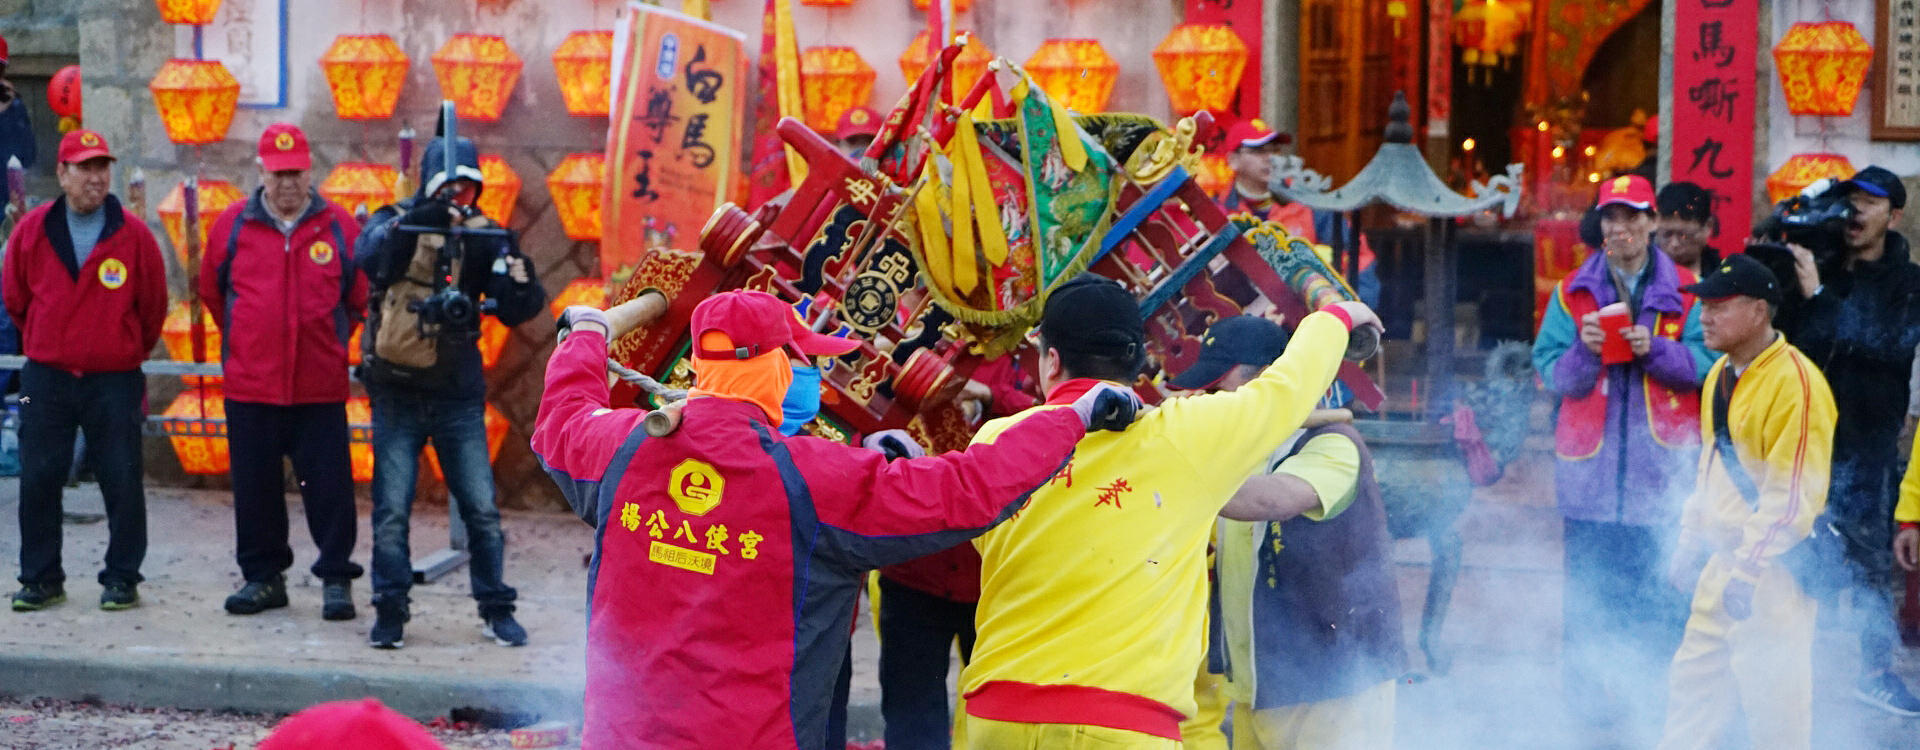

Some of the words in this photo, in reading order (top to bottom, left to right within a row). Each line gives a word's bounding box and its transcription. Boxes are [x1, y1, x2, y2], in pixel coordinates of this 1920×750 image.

[632, 84, 681, 200] 尊王
[678, 44, 723, 169] 白馬
[1686, 0, 1741, 239] 馬嘶九
[620, 501, 764, 560] 楊公八使宮
[650, 545, 713, 571] 馬祖后沃境
